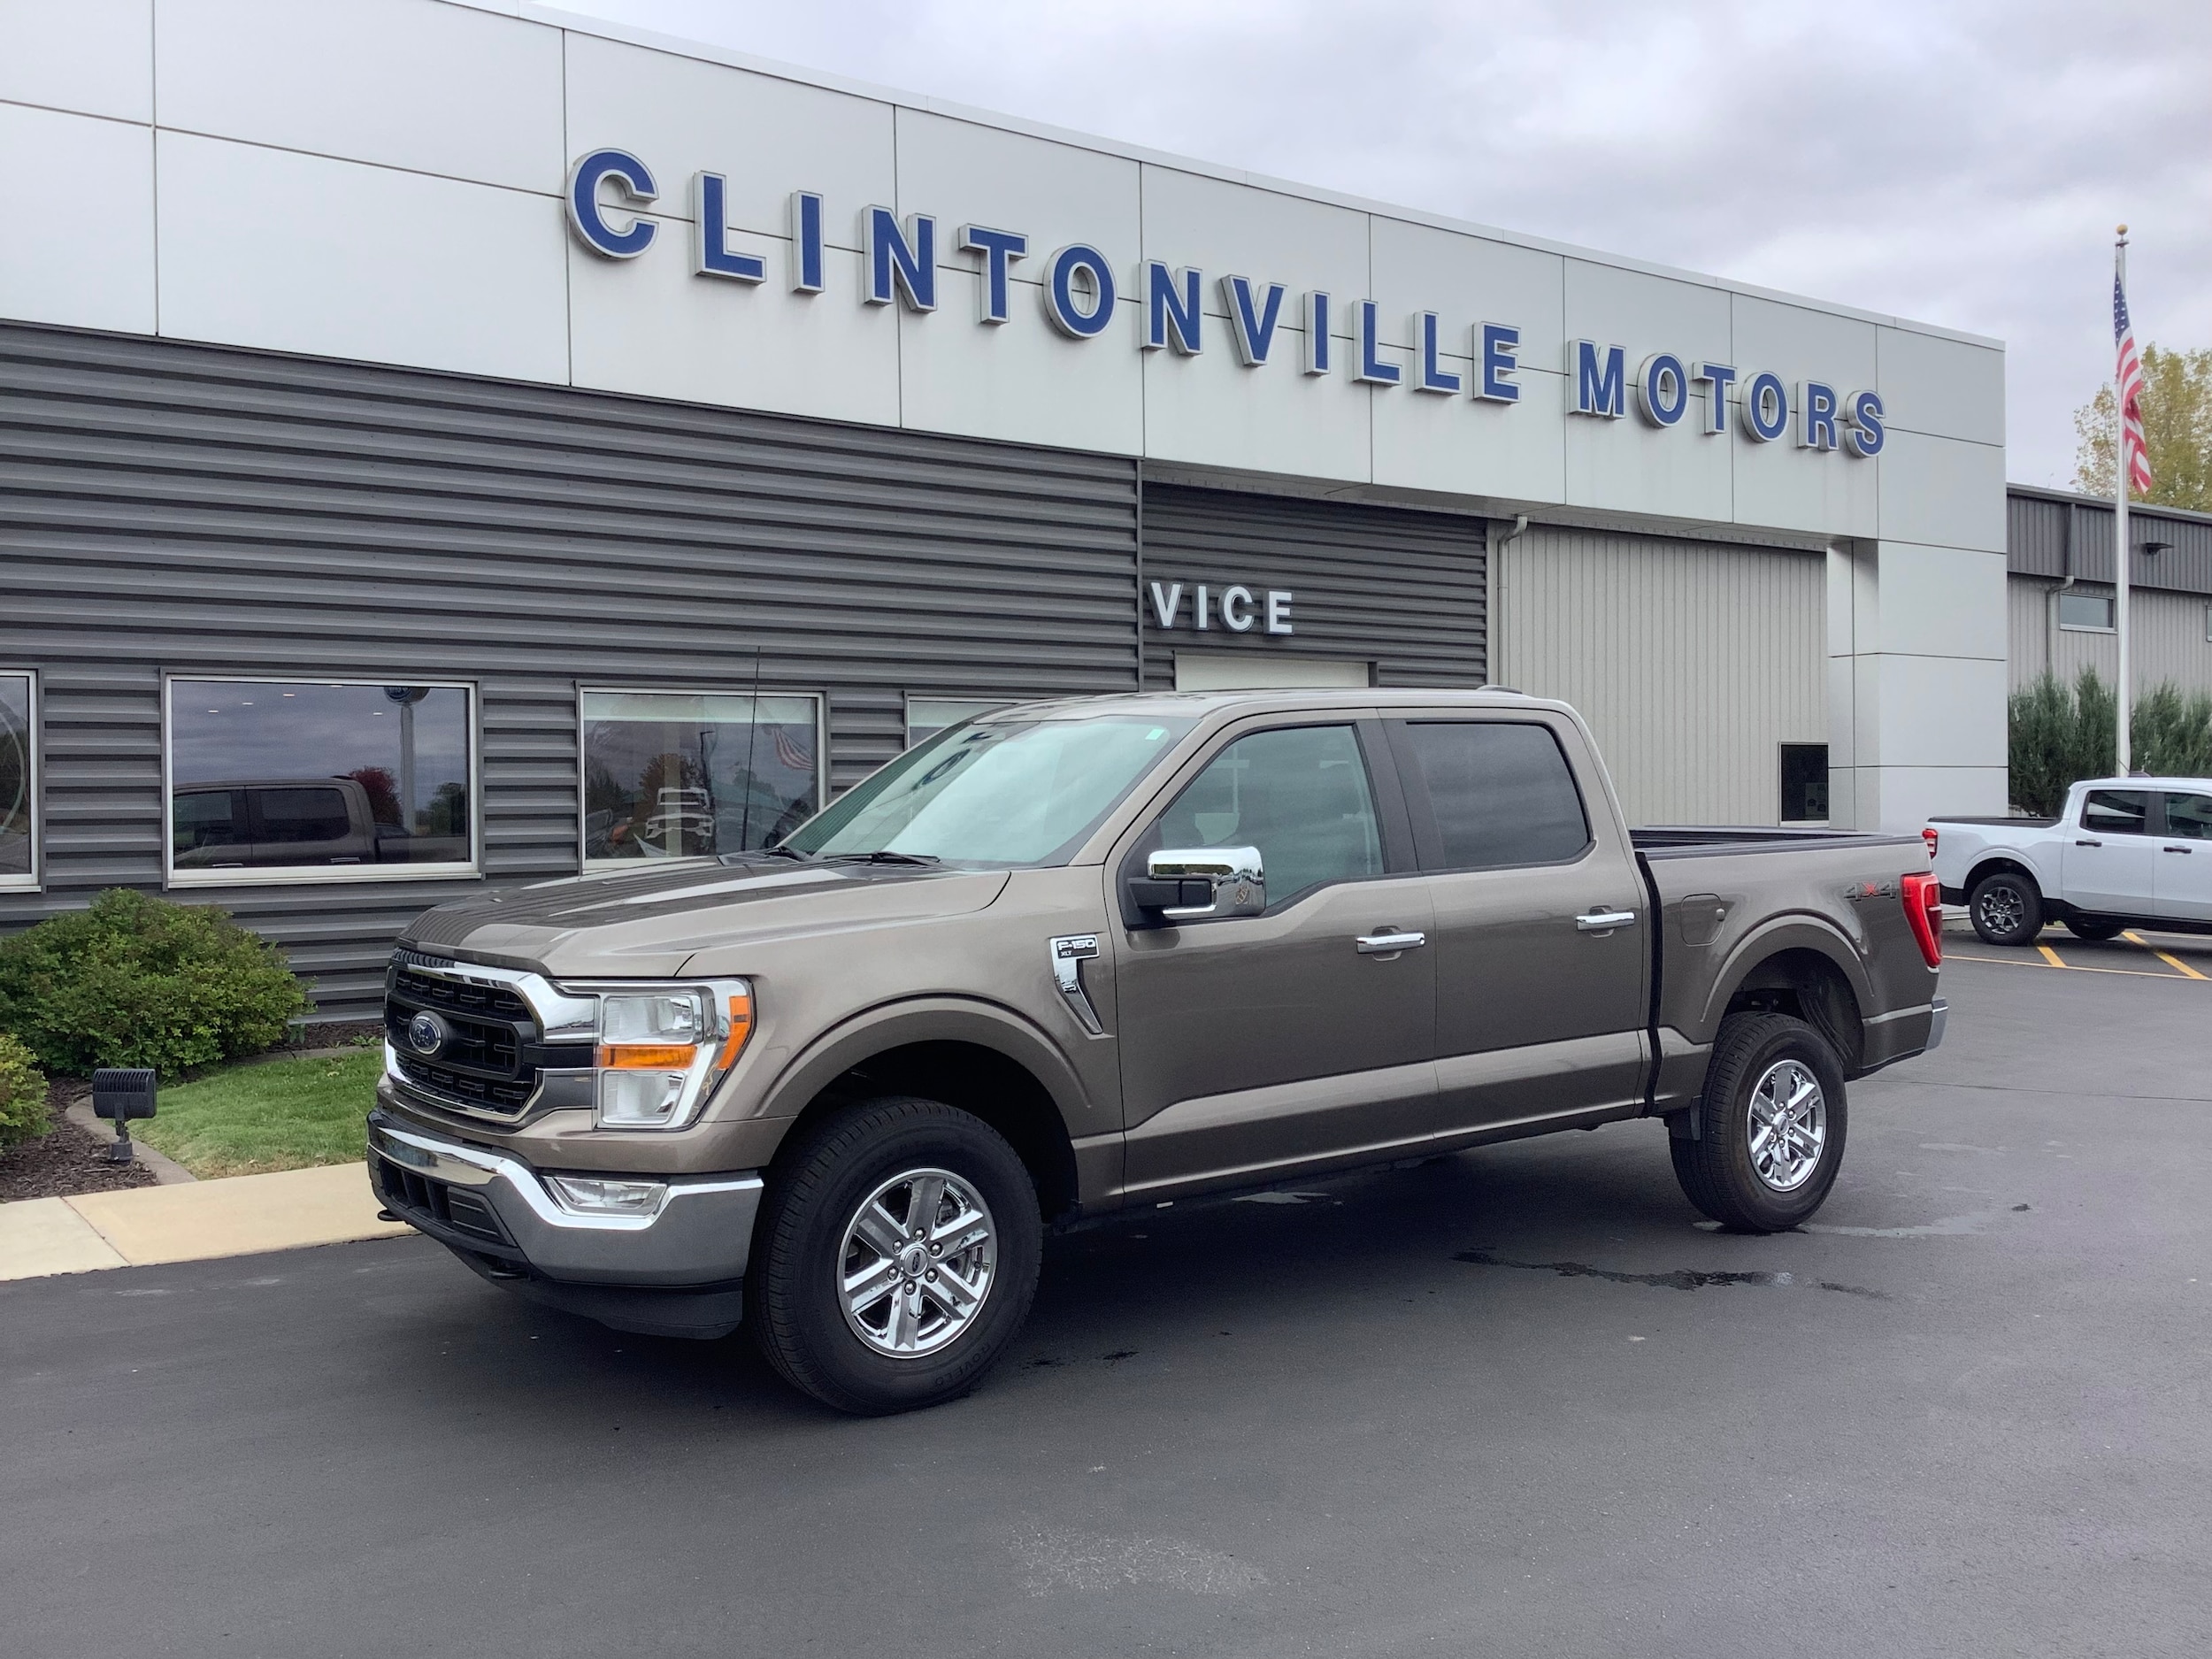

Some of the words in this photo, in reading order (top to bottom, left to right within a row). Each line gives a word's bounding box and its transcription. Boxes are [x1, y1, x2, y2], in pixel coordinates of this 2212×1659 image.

[565, 147, 1522, 404] CLINTONVILLE
[1569, 339, 1886, 457] MOTORS
[1057, 939, 1096, 951] F-150
